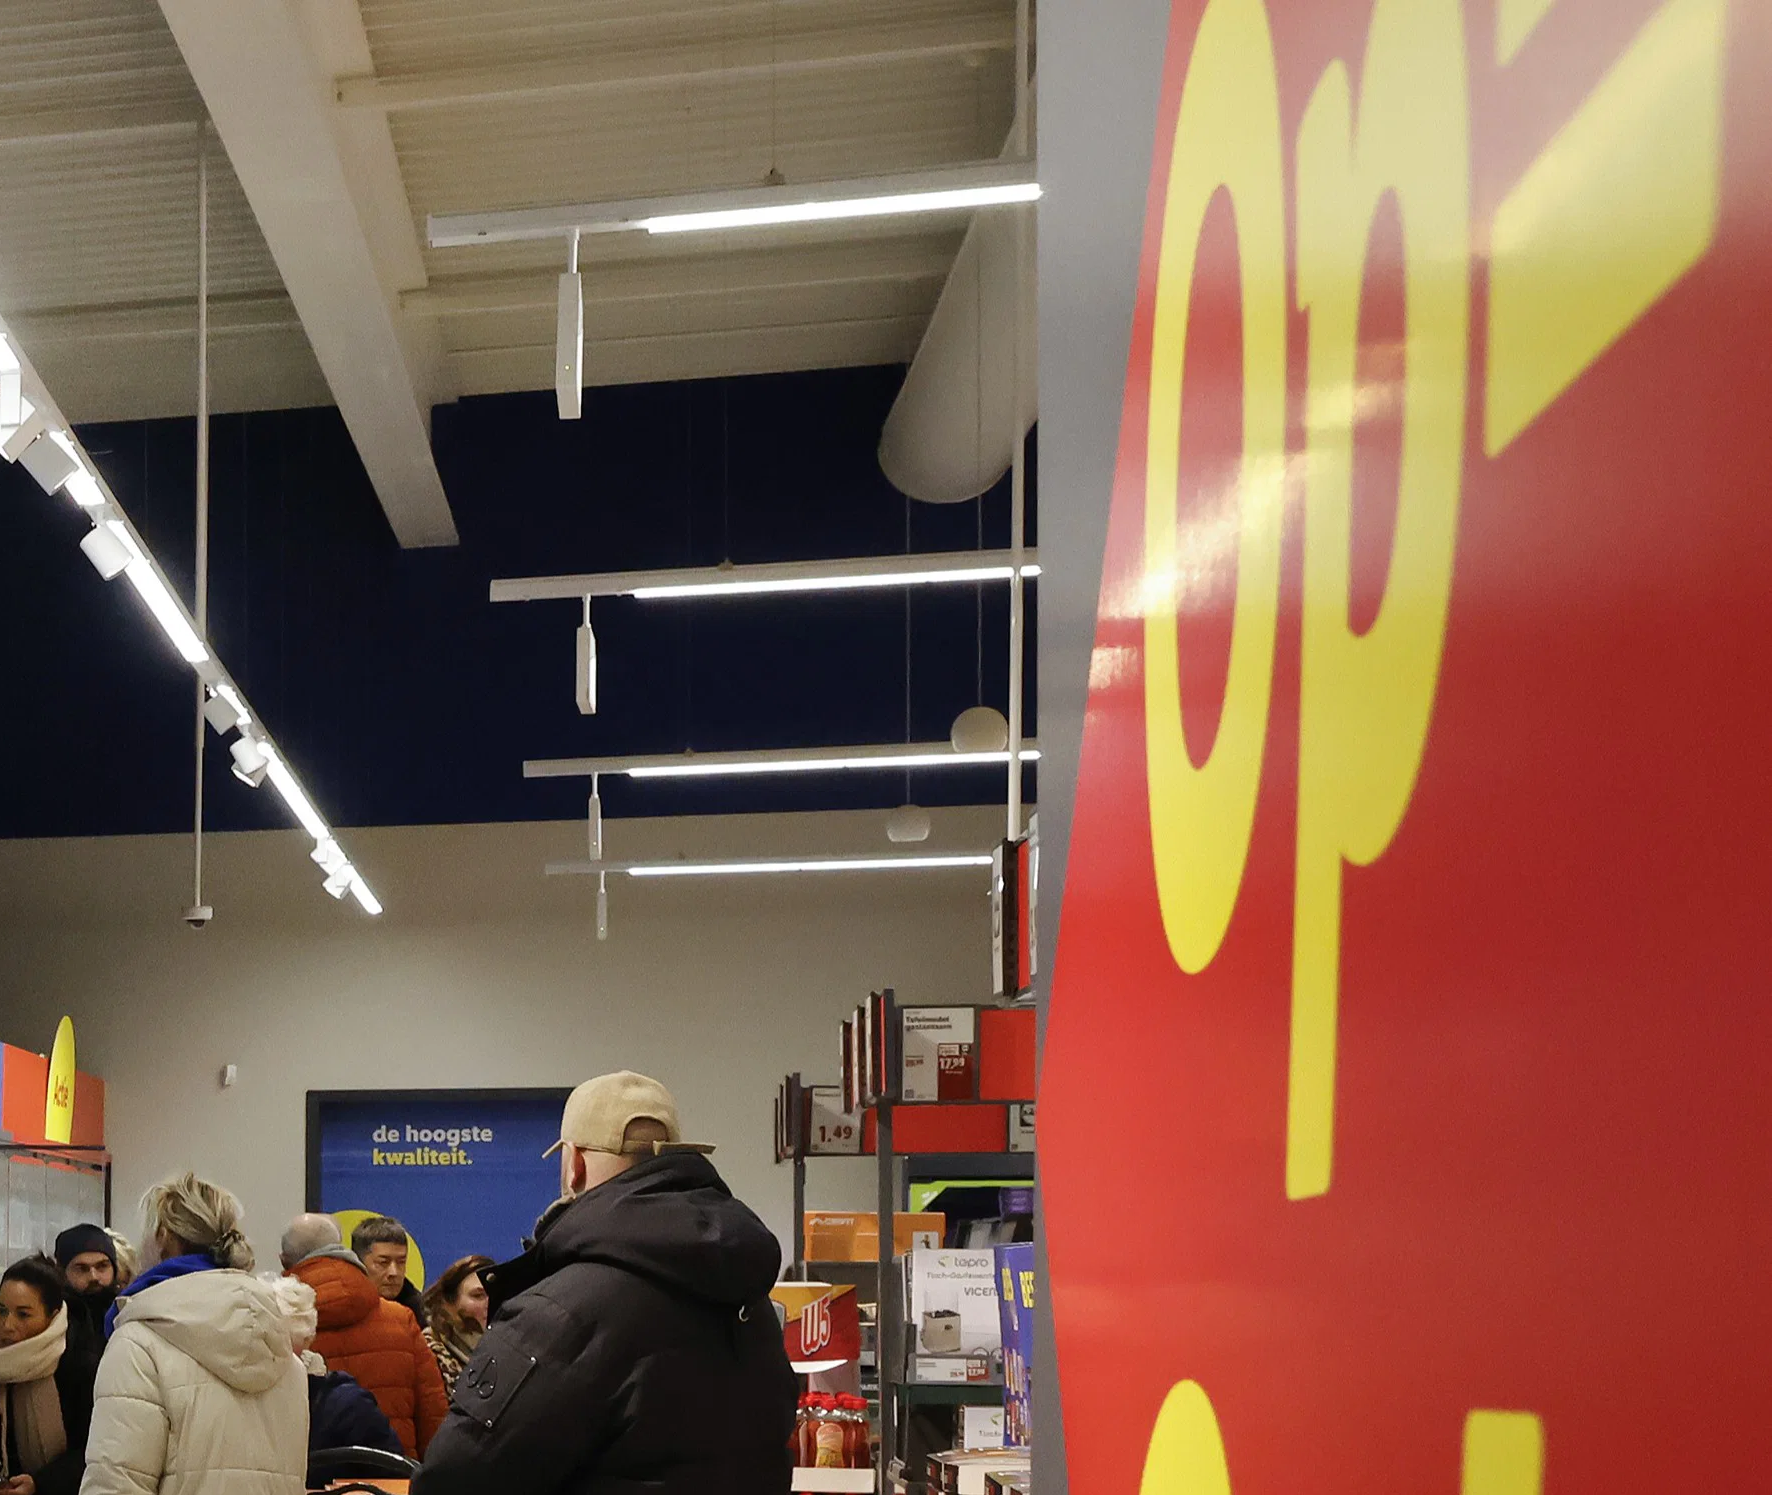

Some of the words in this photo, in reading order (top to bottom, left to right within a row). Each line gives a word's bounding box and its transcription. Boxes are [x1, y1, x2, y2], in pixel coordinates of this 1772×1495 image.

[372, 1124, 400, 1143] de
[405, 1124, 494, 1147] hoogste
[818, 1124, 853, 1143] 1.49
[372, 1146, 474, 1166] kwaliteit.
[953, 1256, 989, 1268] tepro
[963, 1286, 999, 1297] VICEN
